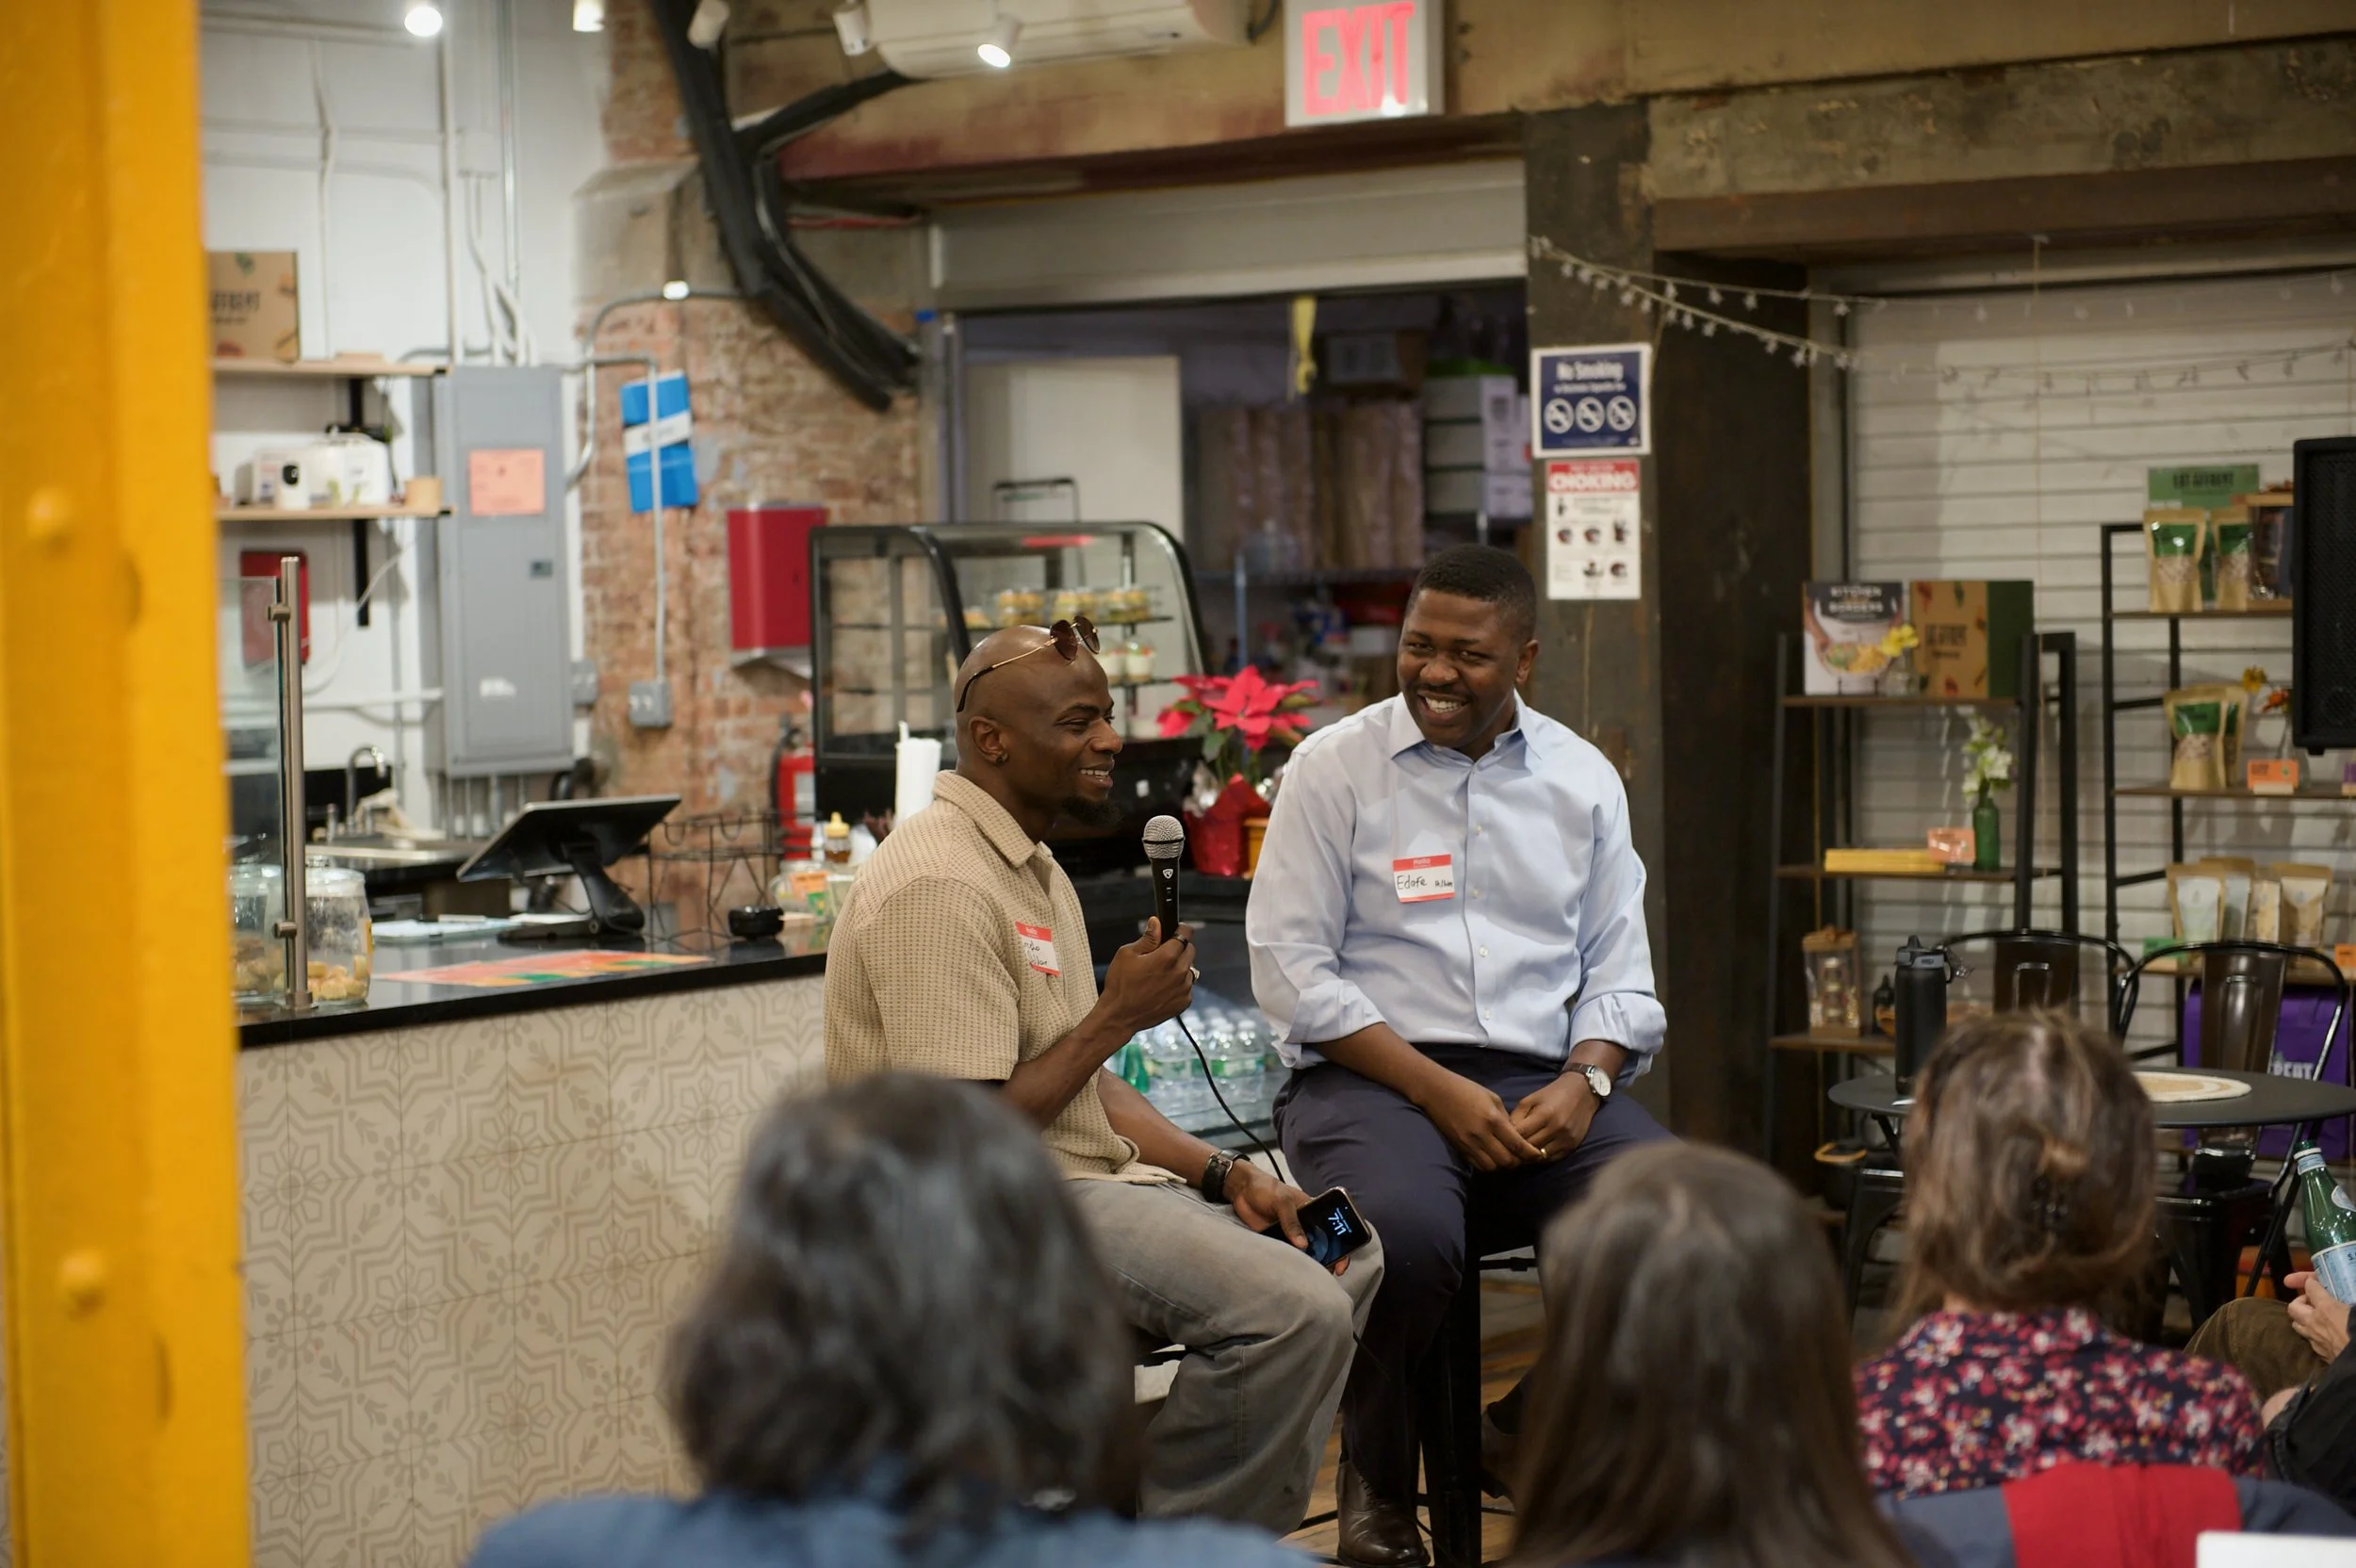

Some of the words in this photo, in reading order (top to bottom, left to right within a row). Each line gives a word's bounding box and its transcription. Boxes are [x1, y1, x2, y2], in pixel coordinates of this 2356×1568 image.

[1302, 1, 1415, 116] EXIT
[1575, 360, 1624, 383] Smoking
[1550, 471, 1637, 490] CHOKING
[1328, 1212, 1347, 1236] 7:11
